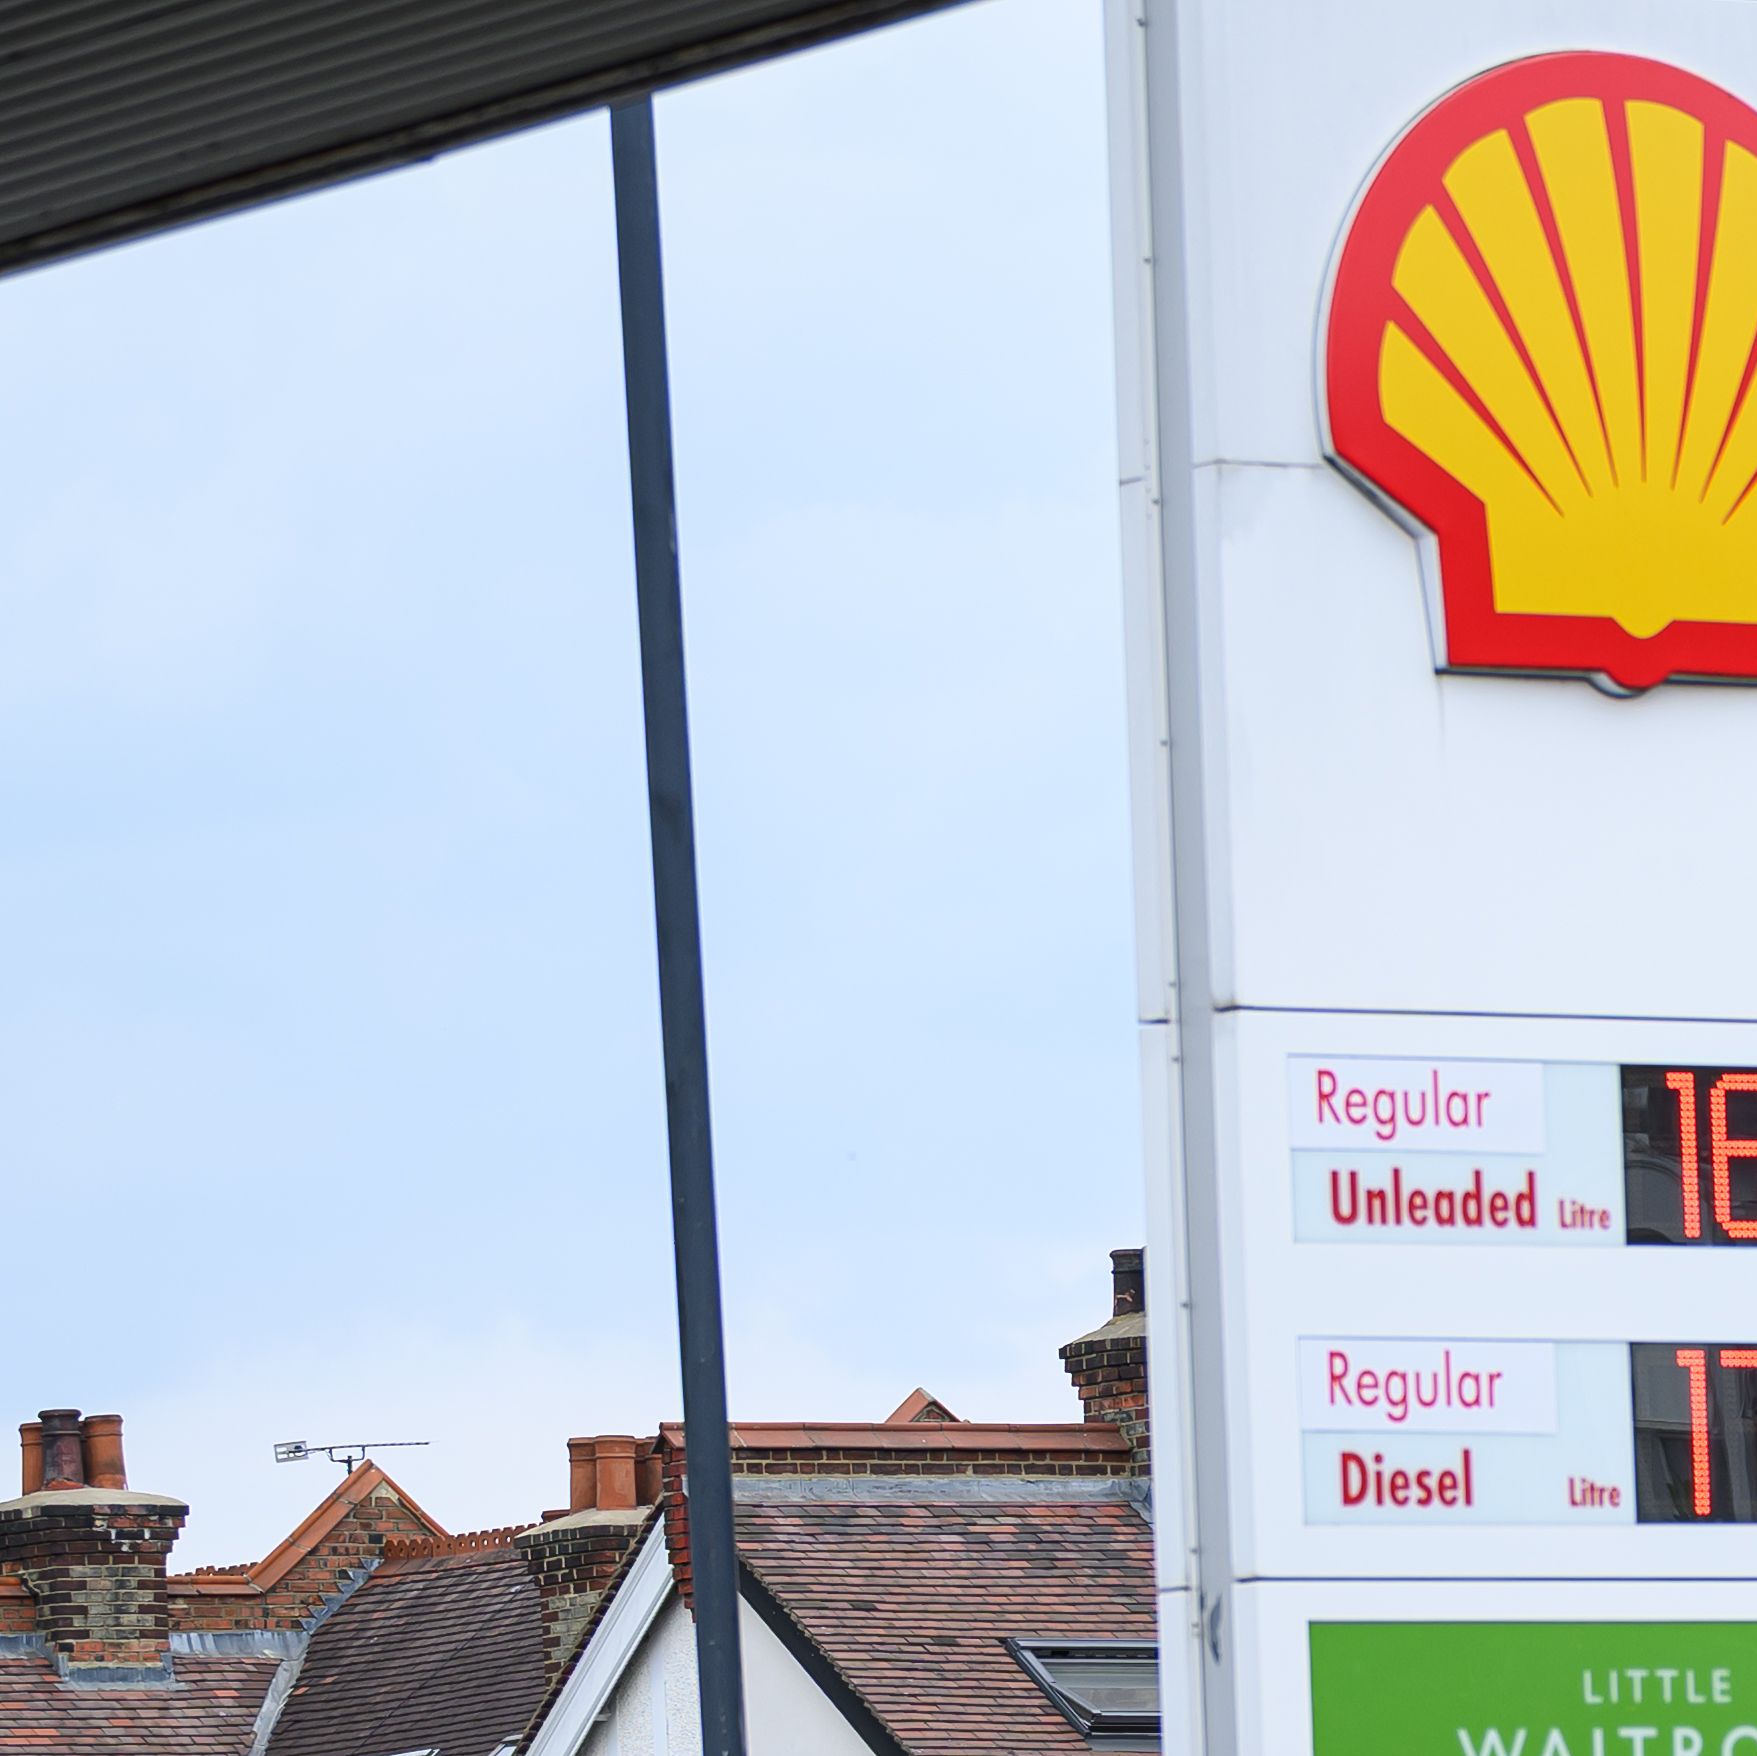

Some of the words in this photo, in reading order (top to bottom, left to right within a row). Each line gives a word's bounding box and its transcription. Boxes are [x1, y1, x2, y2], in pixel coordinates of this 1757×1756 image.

[1316, 1069, 1491, 1141] Regular
[1329, 1168, 1538, 1229] Unleaded
[1558, 1199, 1611, 1231] Litre
[1327, 1349, 1502, 1422] Regular
[1340, 1448, 1473, 1507] Diesel
[1568, 1477, 1621, 1508] Litre
[1583, 1668, 1733, 1704] LITTLE
